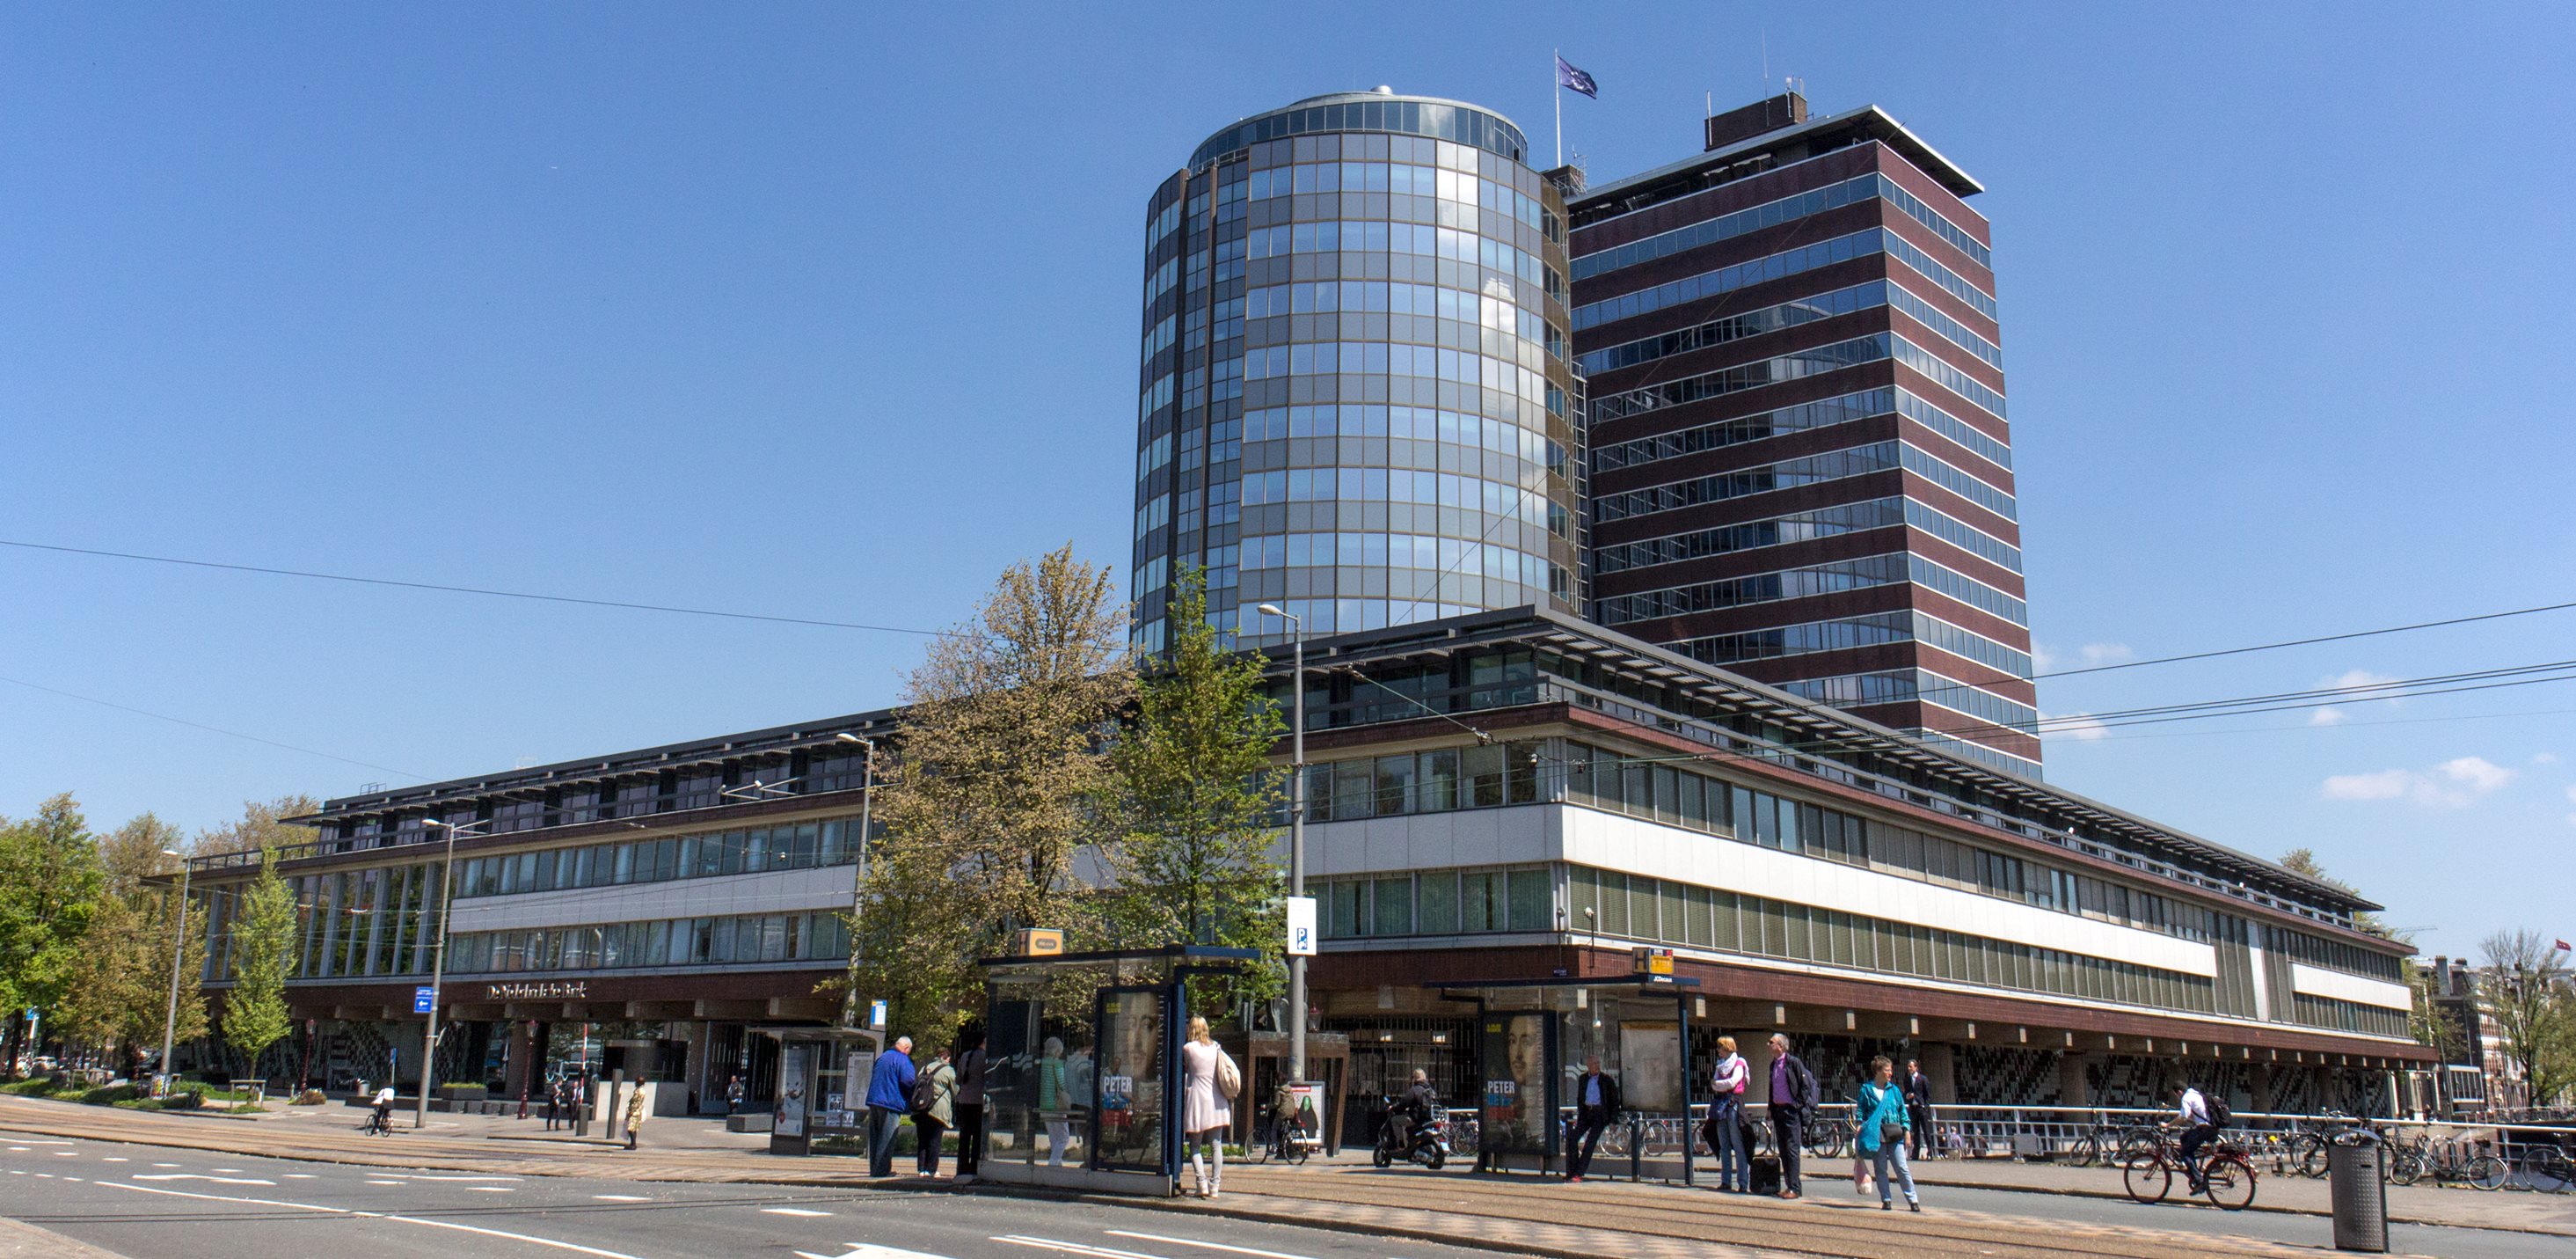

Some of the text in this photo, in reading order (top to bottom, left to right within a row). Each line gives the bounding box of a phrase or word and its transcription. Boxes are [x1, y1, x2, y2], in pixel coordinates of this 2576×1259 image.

[1635, 950, 1647, 969] H
[1104, 1076, 1133, 1093] PETER
[1487, 1080, 1515, 1094] PETER
